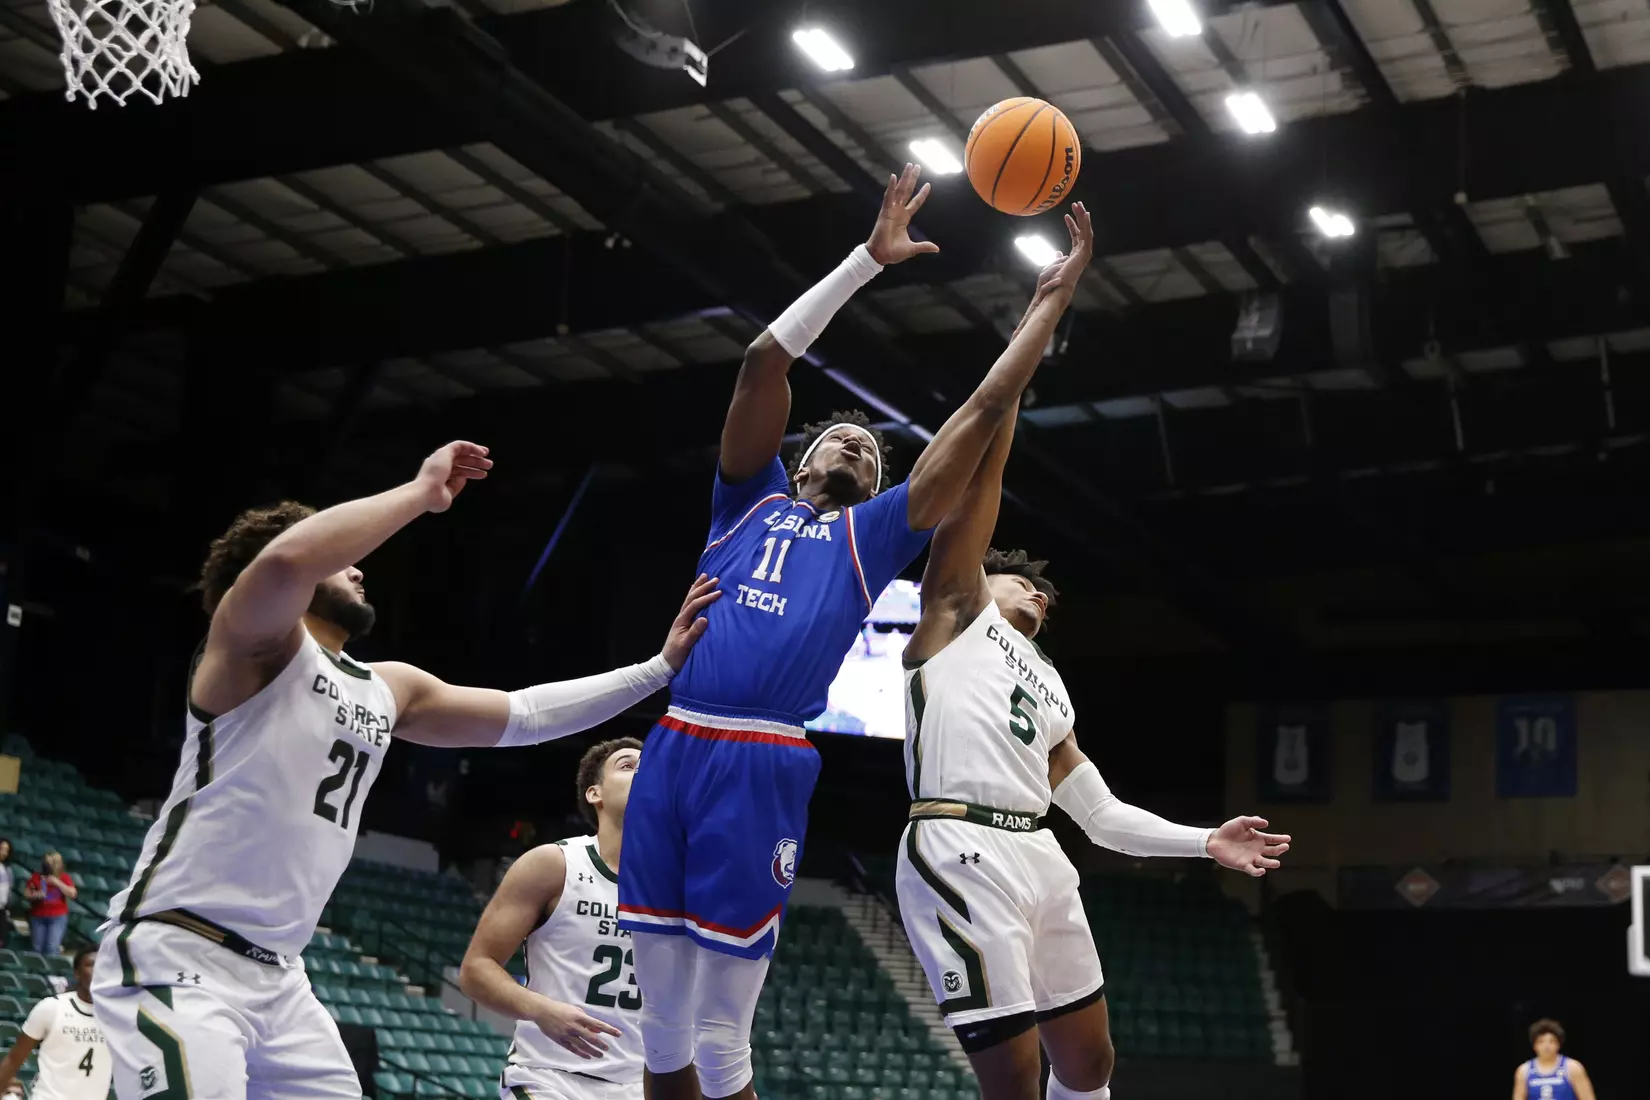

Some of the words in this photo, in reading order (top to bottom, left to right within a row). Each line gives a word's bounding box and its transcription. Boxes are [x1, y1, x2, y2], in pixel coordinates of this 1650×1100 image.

[751, 536, 792, 584] 11
[736, 583, 788, 616] TECH
[1008, 683, 1038, 746] 5
[312, 738, 371, 830] 21
[991, 811, 1032, 831] RAMS
[585, 944, 643, 1011] 23
[78, 1047, 94, 1078] 4
